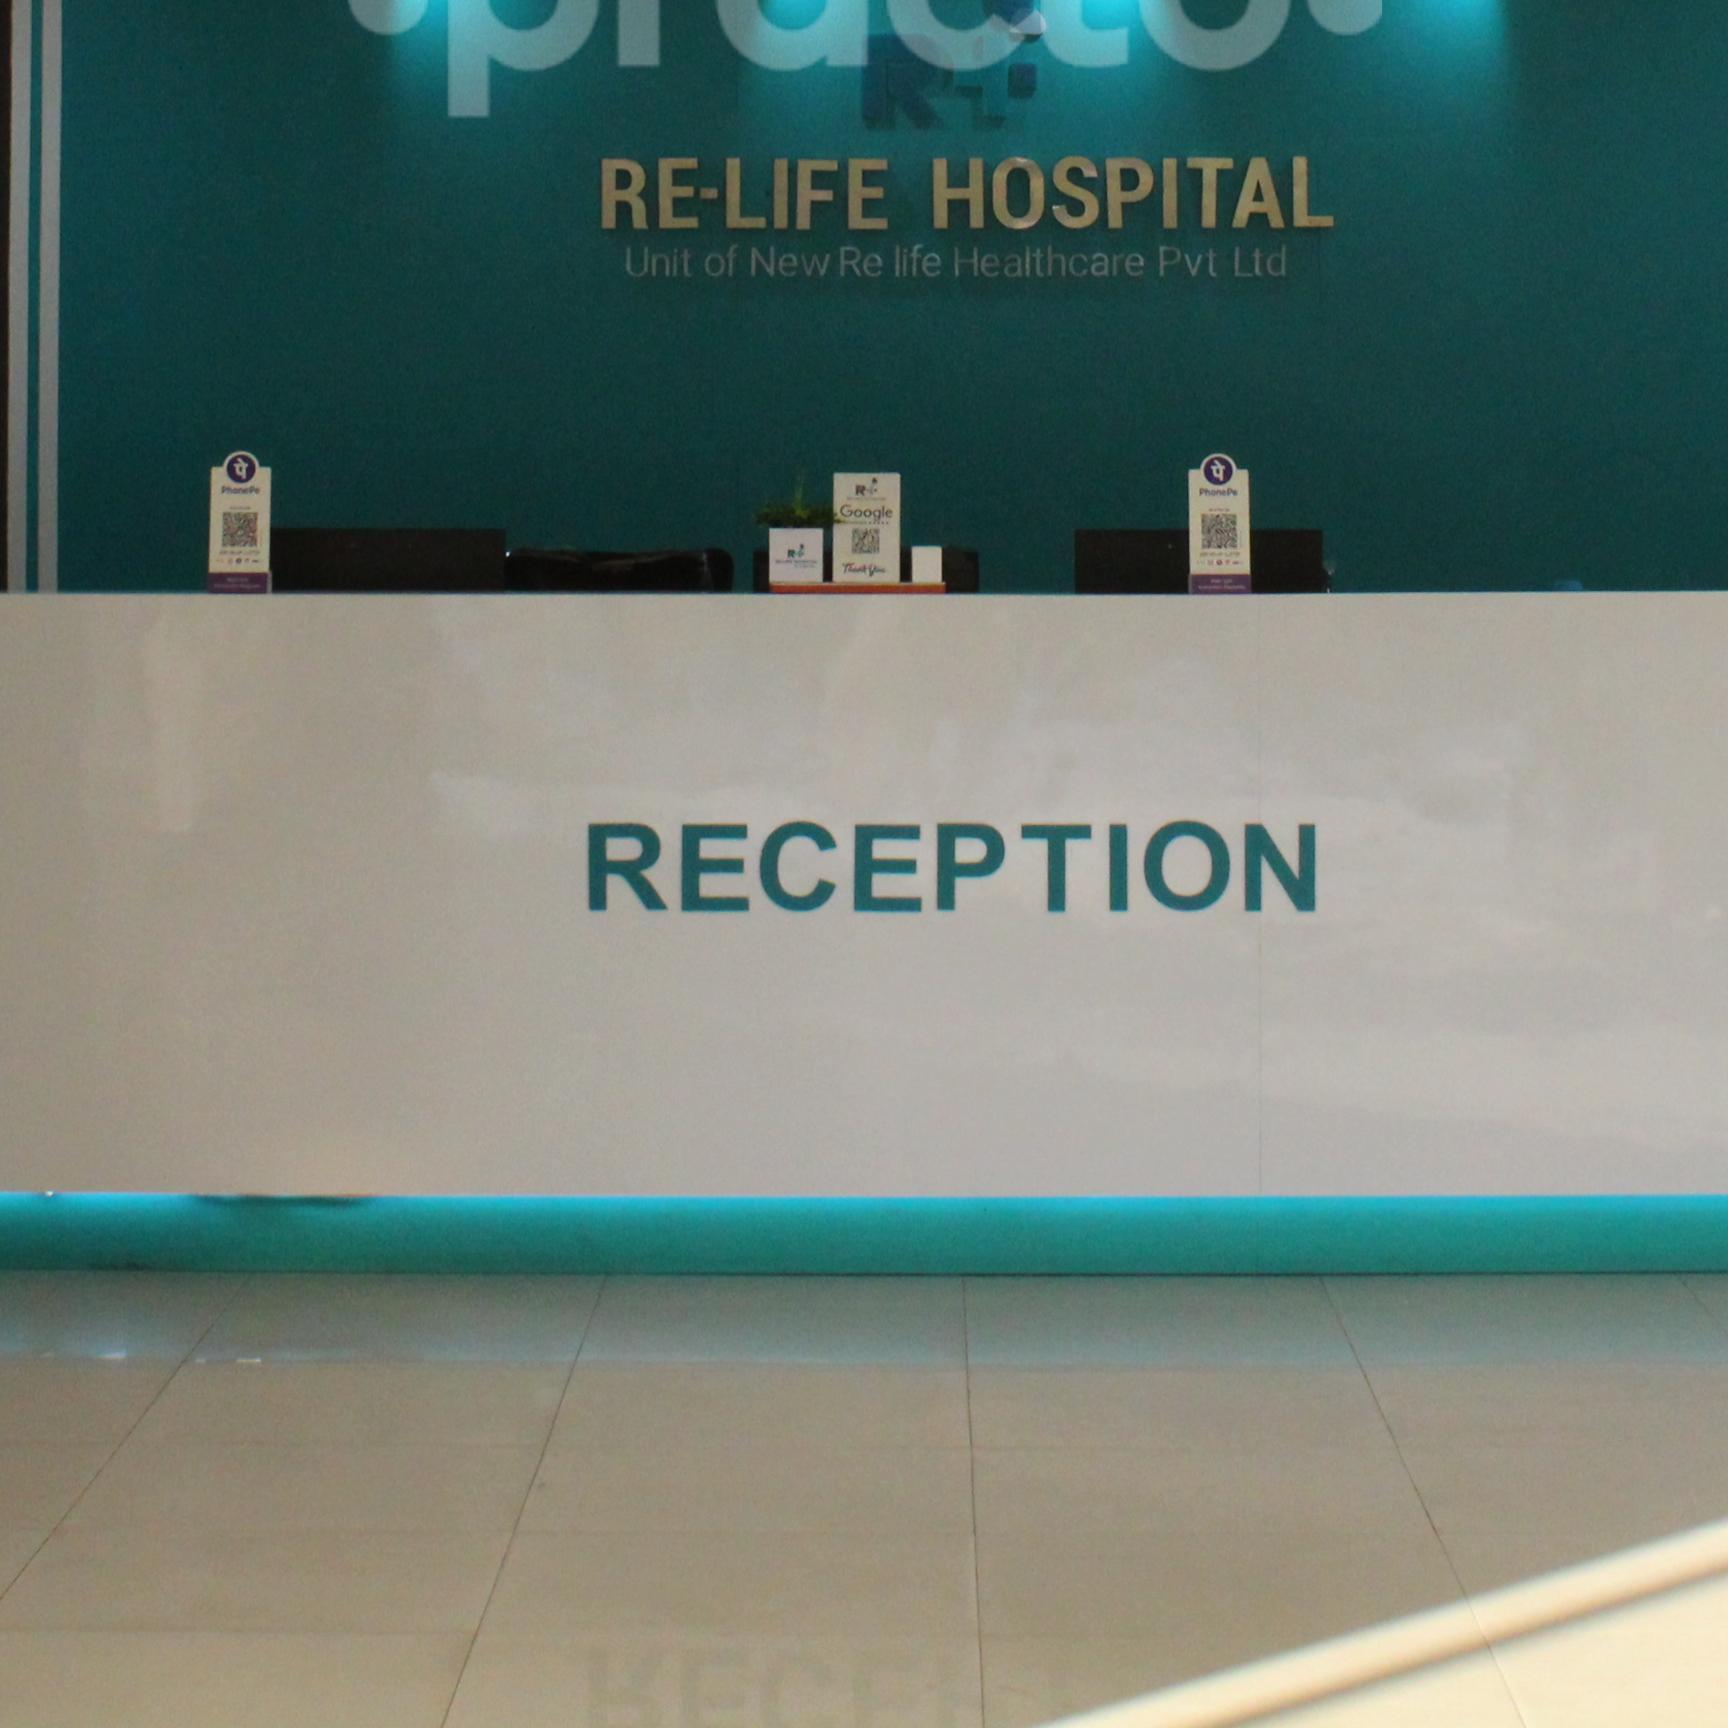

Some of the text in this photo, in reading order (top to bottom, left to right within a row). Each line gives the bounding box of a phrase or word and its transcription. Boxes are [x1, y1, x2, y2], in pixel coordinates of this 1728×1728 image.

[601, 156, 1334, 230] RE-LIFE HOSPITAL
[624, 244, 1287, 277] Unit of New Re life Healthcare Pvt Ltd
[1199, 488, 1238, 497] PhonePe
[840, 504, 893, 521] Google
[587, 821, 1317, 913] RECEPTION
